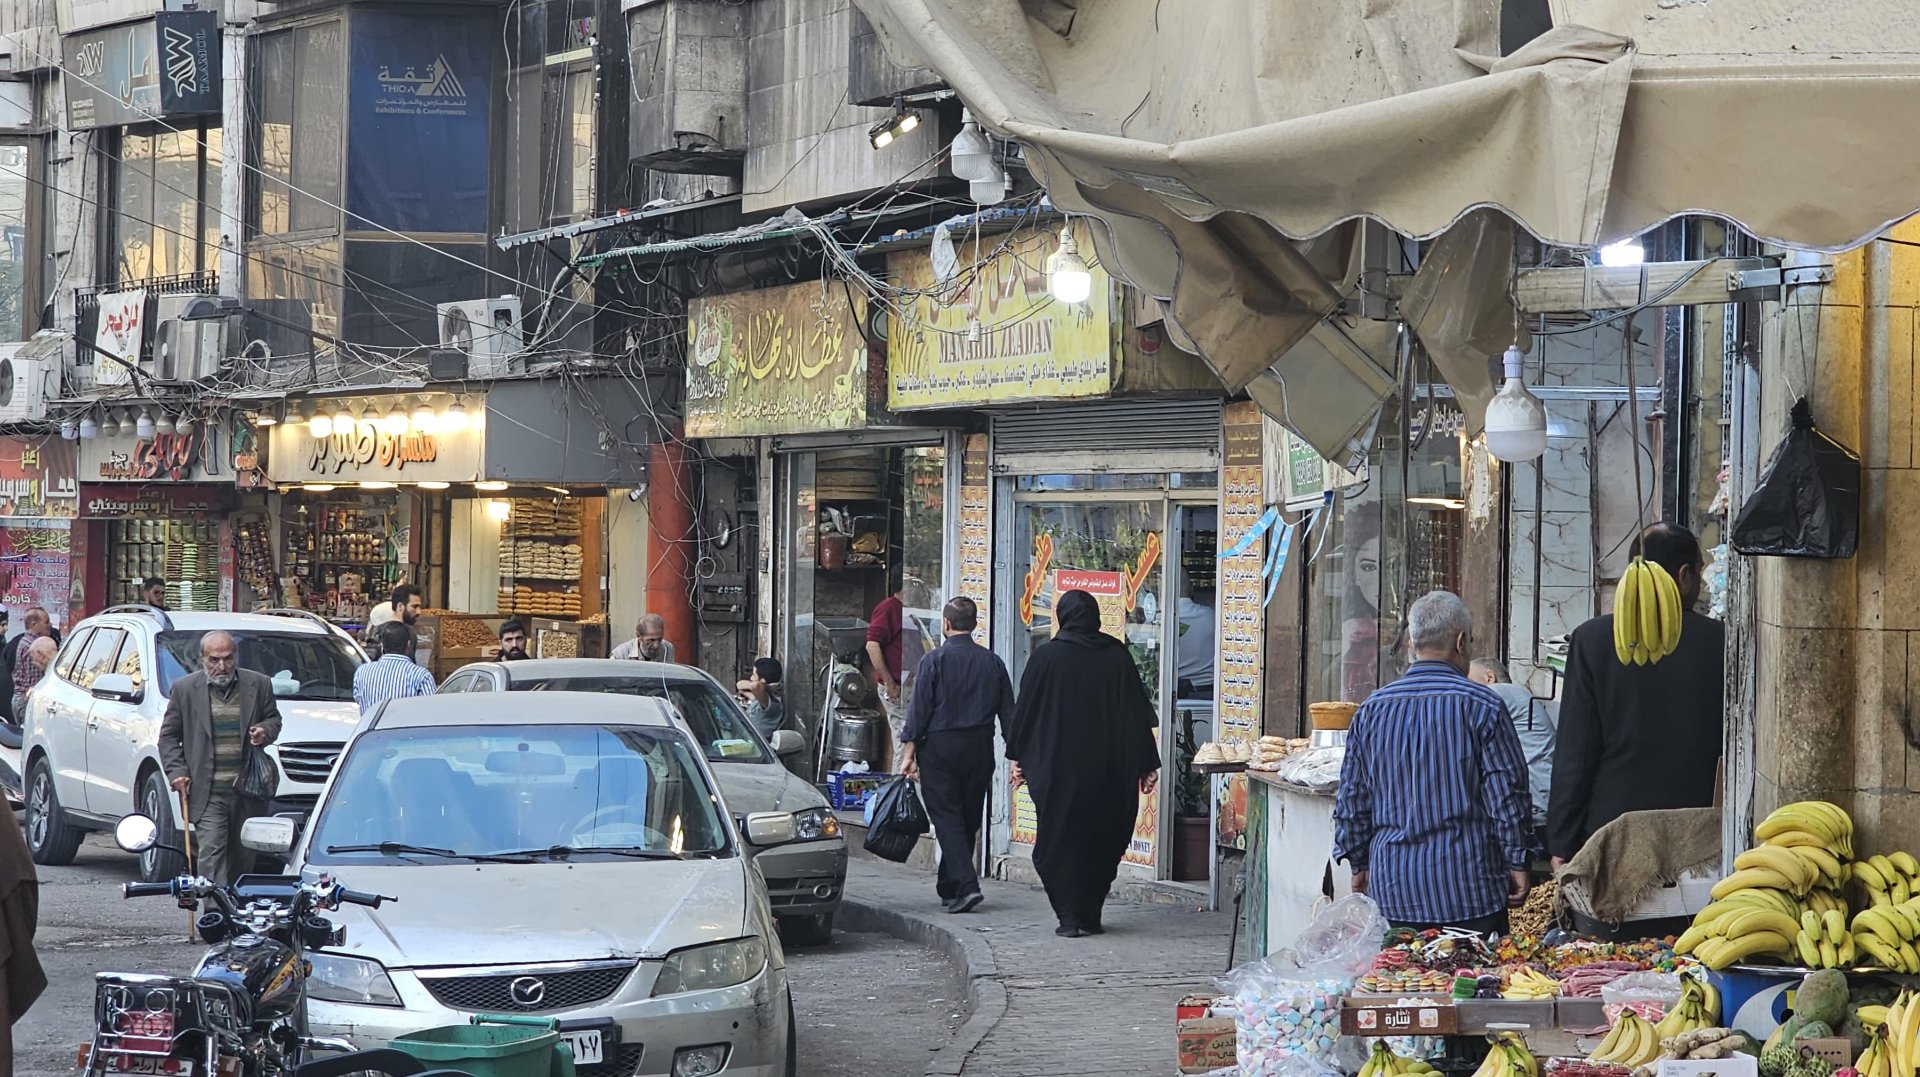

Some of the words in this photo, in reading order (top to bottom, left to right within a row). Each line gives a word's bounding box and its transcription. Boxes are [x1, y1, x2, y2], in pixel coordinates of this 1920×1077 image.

[377, 63, 434, 83] ثقة
[375, 106, 415, 114] Exhibitions
[422, 107, 467, 116] Conferences
[785, 318, 845, 380] عطارة
[938, 326, 997, 364] MANAHIL
[1000, 318, 1053, 357] ZEADAN
[1060, 361, 1078, 385] طبيعي
[1078, 361, 1092, 382] بلدي
[1093, 360, 1107, 379] عسل
[34, 551, 67, 566] ملحمة
[1123, 531, 1160, 613] عسل
[1133, 839, 1152, 854] HONEY
